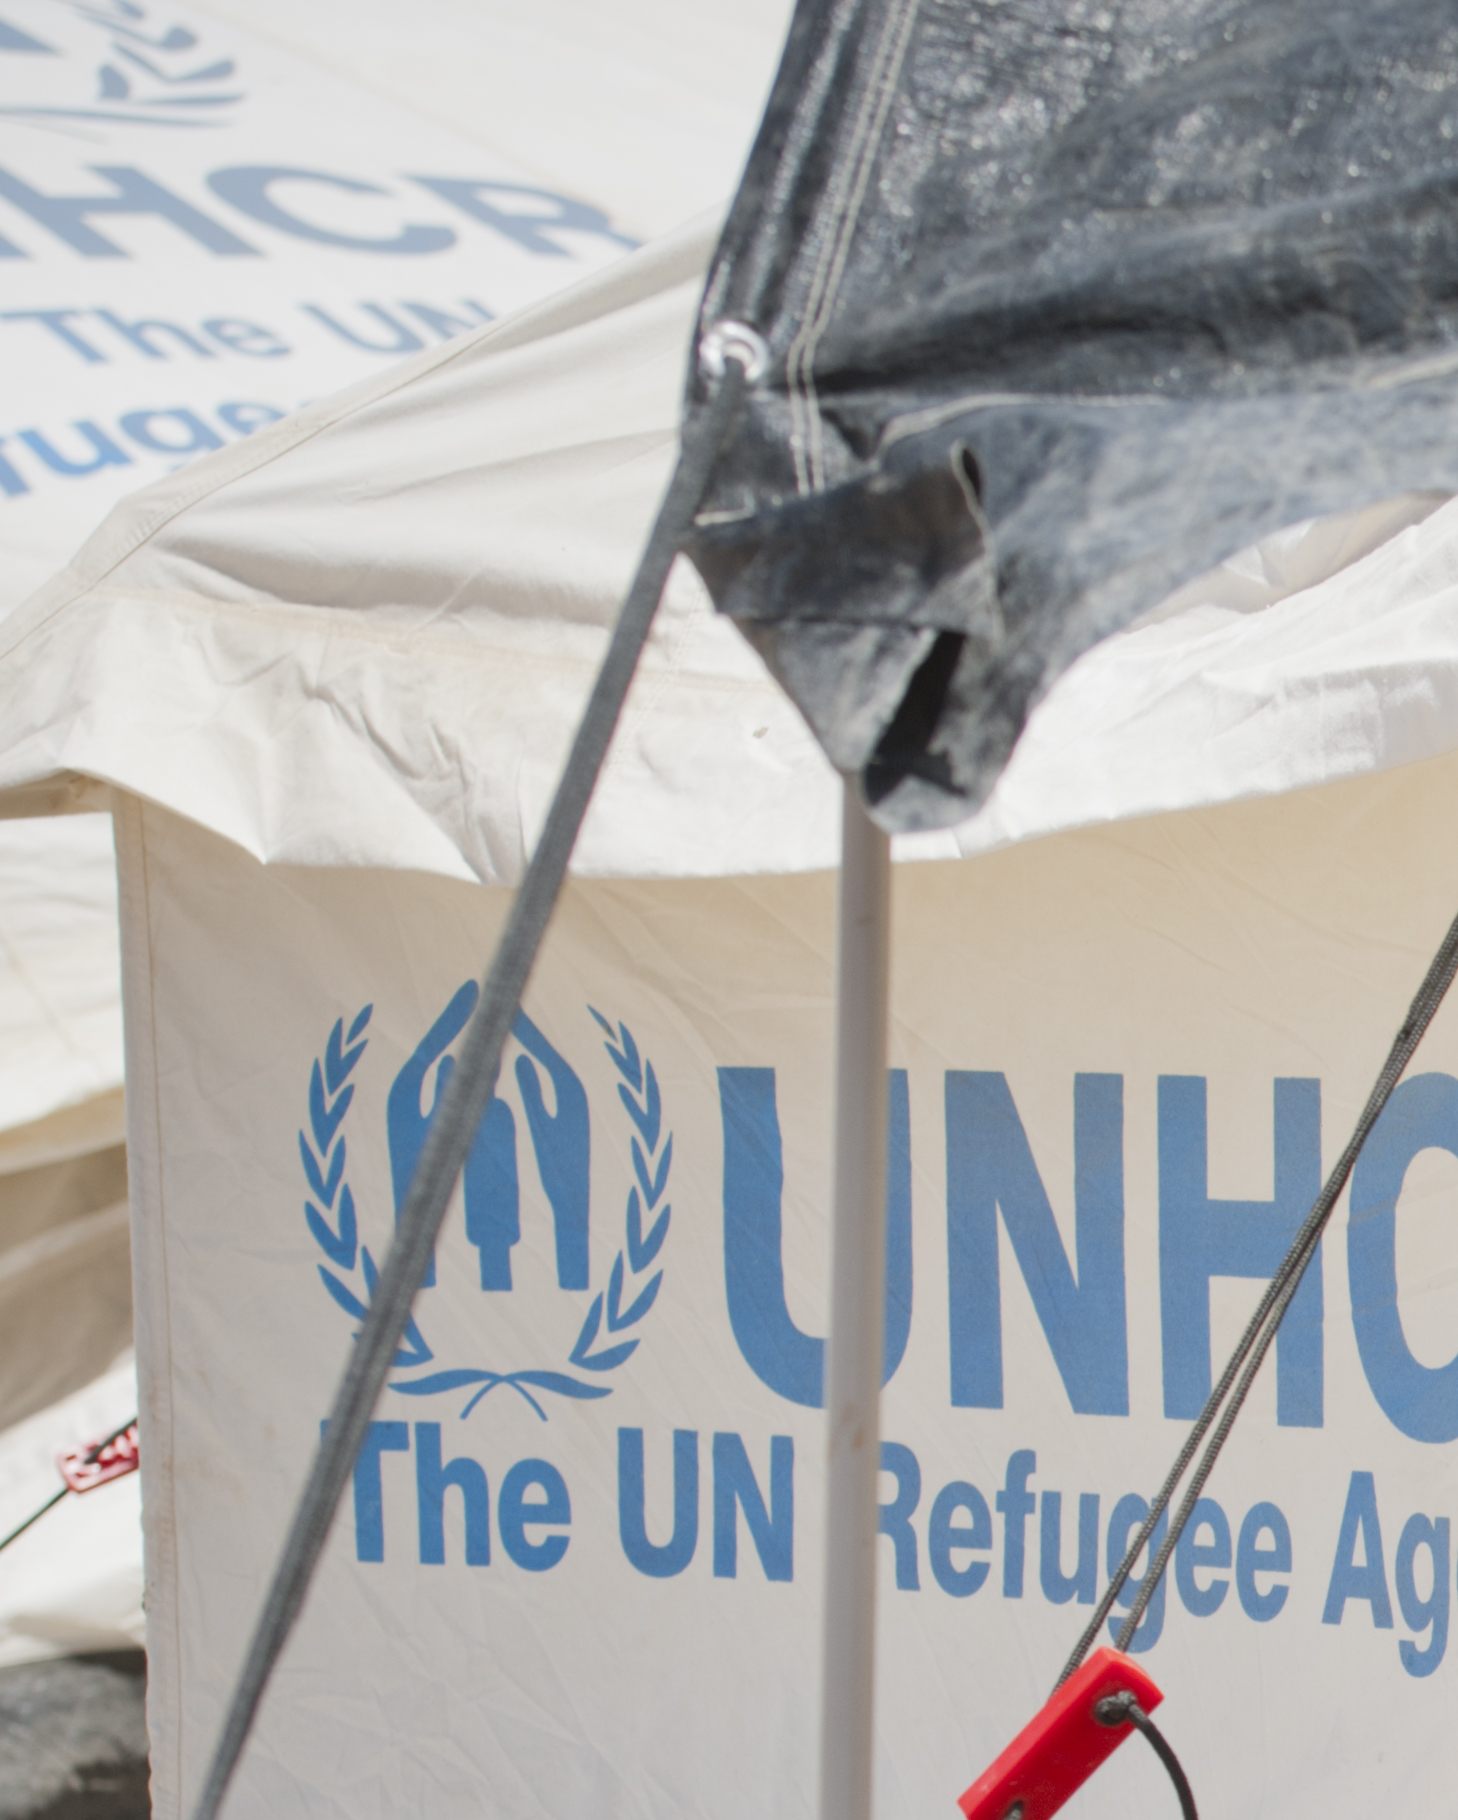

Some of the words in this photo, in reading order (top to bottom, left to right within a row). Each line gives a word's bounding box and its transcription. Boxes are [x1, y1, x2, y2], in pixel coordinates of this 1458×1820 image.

[0, 163, 648, 262] HCR
[0, 304, 293, 366] The
[320, 1420, 572, 1573] The
[617, 1426, 794, 1583] UN
[876, 1441, 1292, 1654] Refugee
